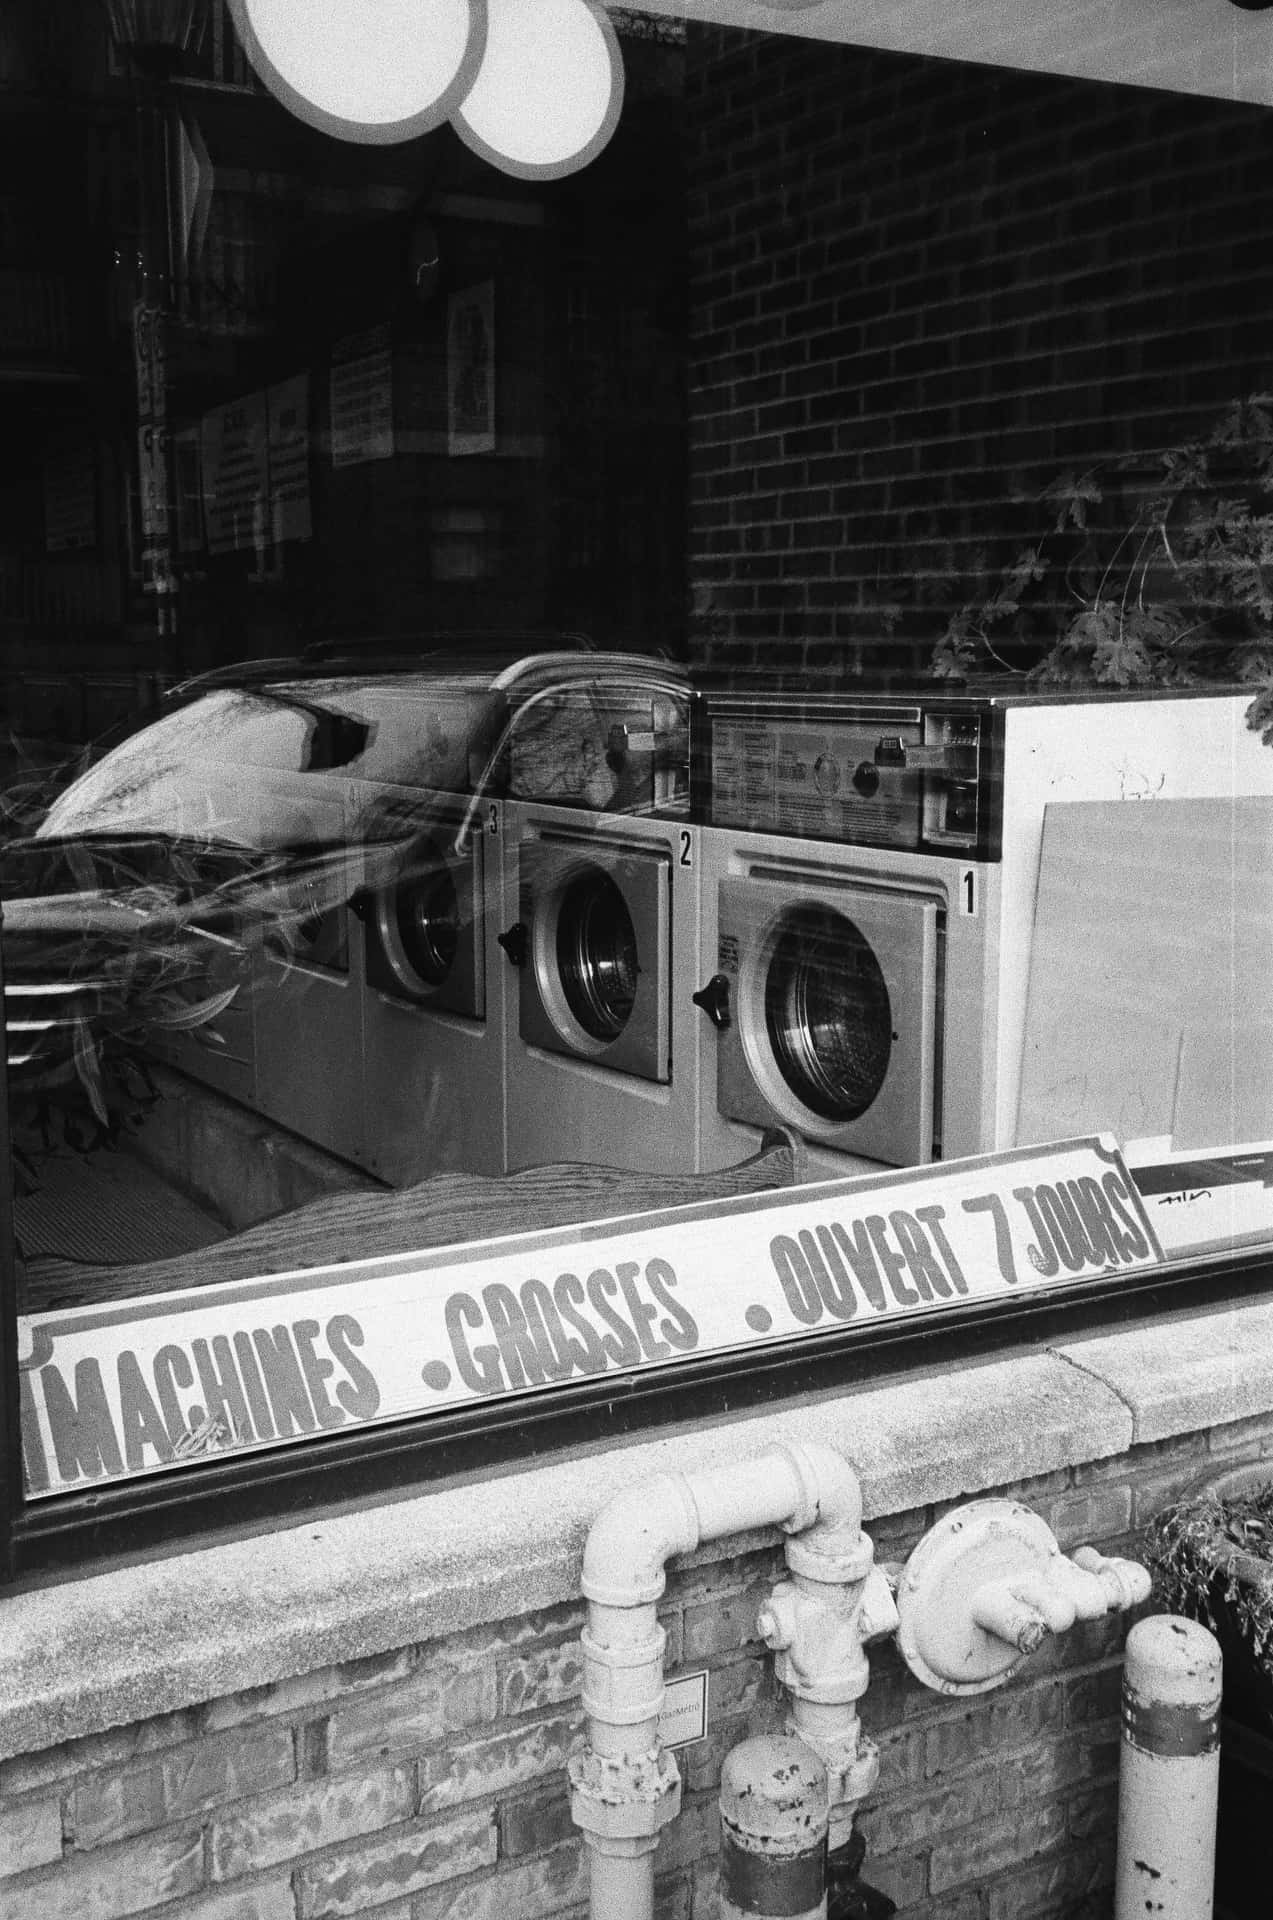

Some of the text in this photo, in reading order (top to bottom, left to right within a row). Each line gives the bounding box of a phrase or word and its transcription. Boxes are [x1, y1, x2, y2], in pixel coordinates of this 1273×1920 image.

[489, 804, 498, 834] 3
[680, 831, 692, 866] 2
[963, 870, 974, 914] 1
[40, 1171, 1150, 1482] MACHINES GROSSES OUVERT 7 JOURS
